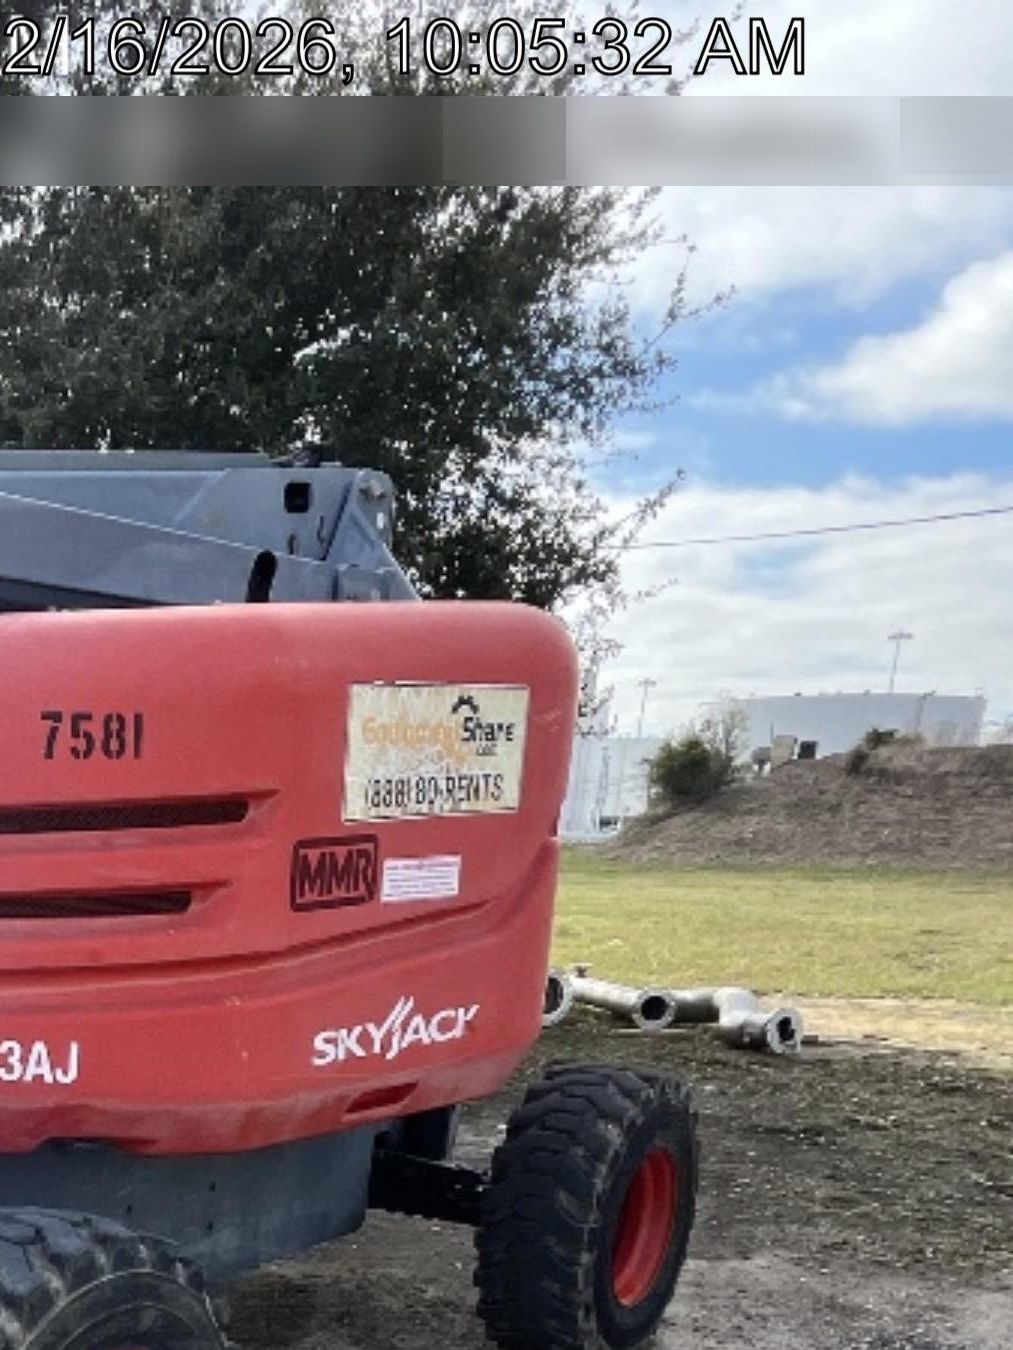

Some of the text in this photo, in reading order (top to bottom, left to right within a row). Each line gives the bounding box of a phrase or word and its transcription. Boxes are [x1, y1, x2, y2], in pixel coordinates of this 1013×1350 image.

[40, 710, 144, 760] 7581
[299, 848, 375, 901] MMR
[312, 995, 480, 1066] SKYJACK
